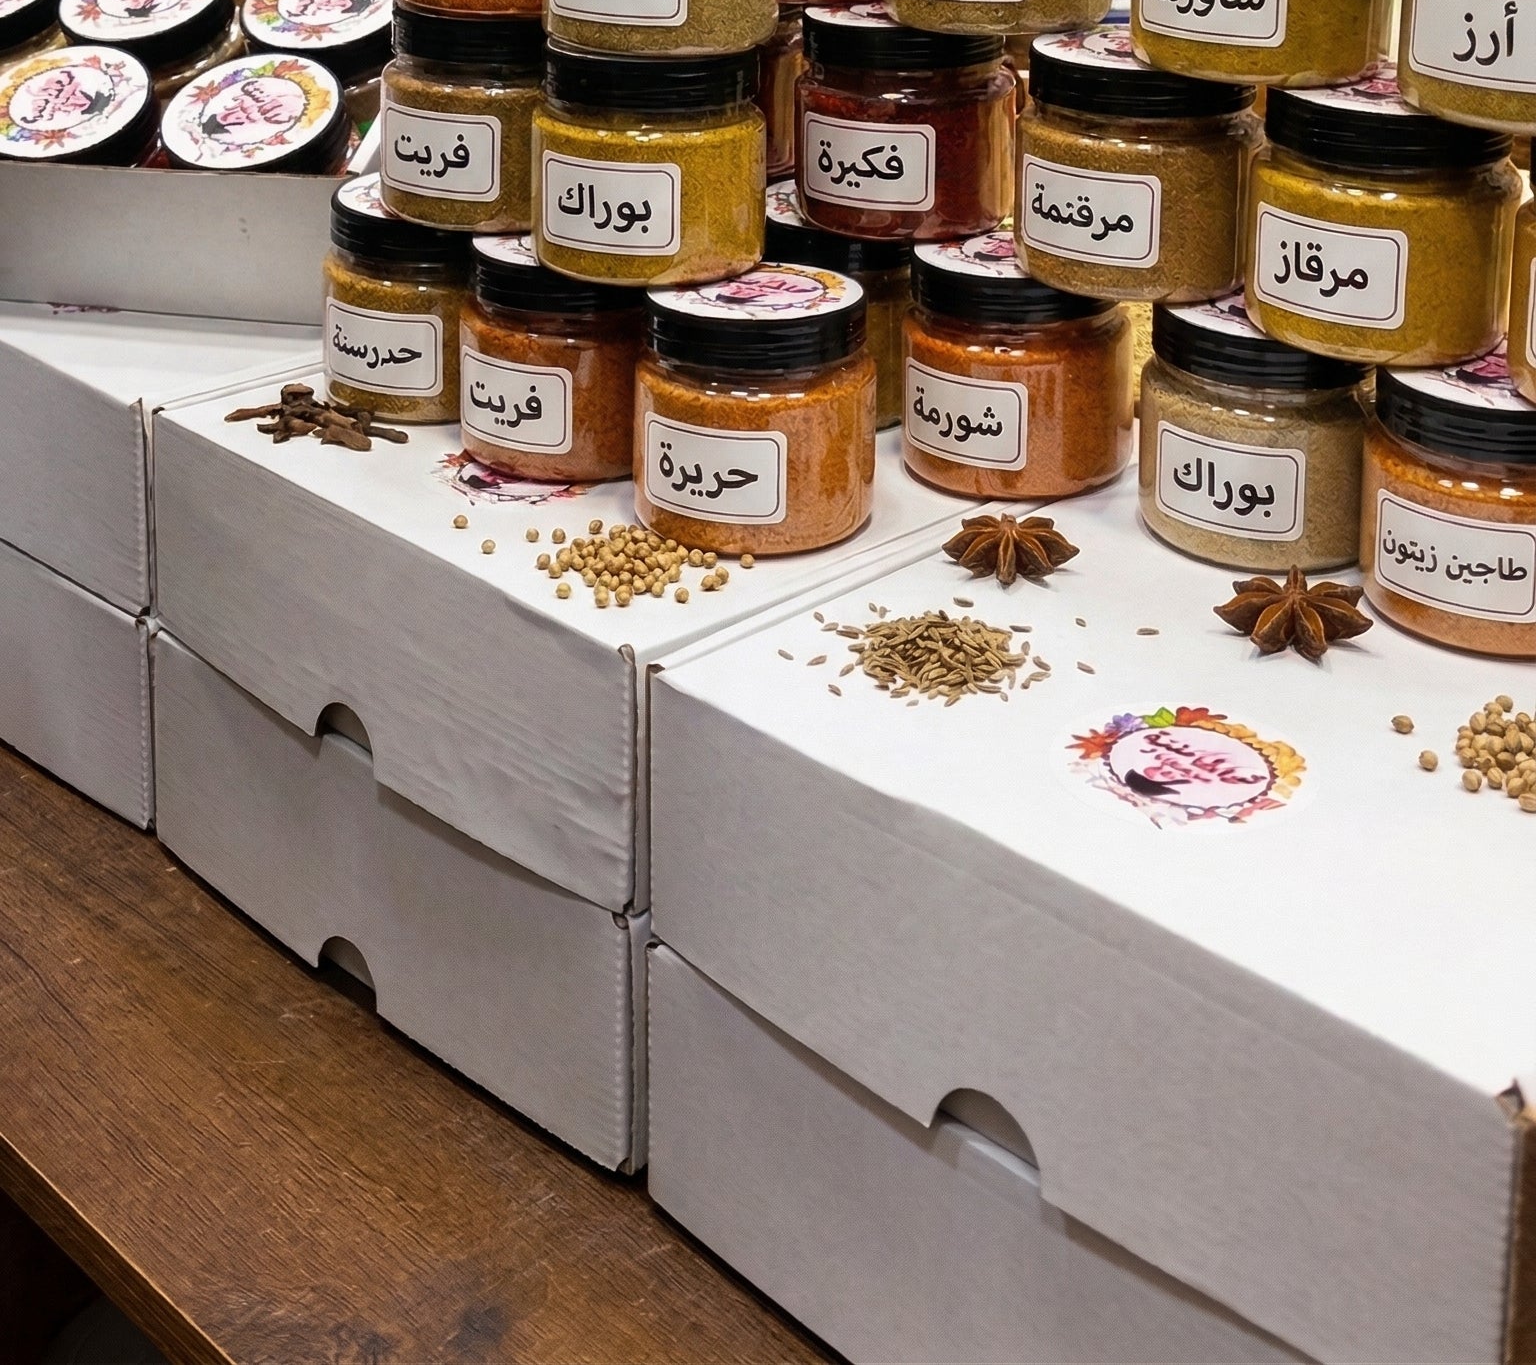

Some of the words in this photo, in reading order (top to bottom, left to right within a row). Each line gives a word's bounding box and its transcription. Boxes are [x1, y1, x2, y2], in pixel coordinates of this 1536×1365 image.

[1452, 0, 1518, 66] أرز
[394, 133, 470, 179] فريت
[817, 139, 905, 189] فكيرة
[557, 182, 652, 234] بوراك
[1273, 240, 1369, 298] مرقاز
[468, 378, 543, 429] فريت
[912, 385, 1003, 443] شورمة
[658, 441, 759, 498] حريرة
[1173, 456, 1276, 519] بوراك
[1382, 529, 1438, 573] زيتون
[1445, 556, 1528, 584] طاجين
